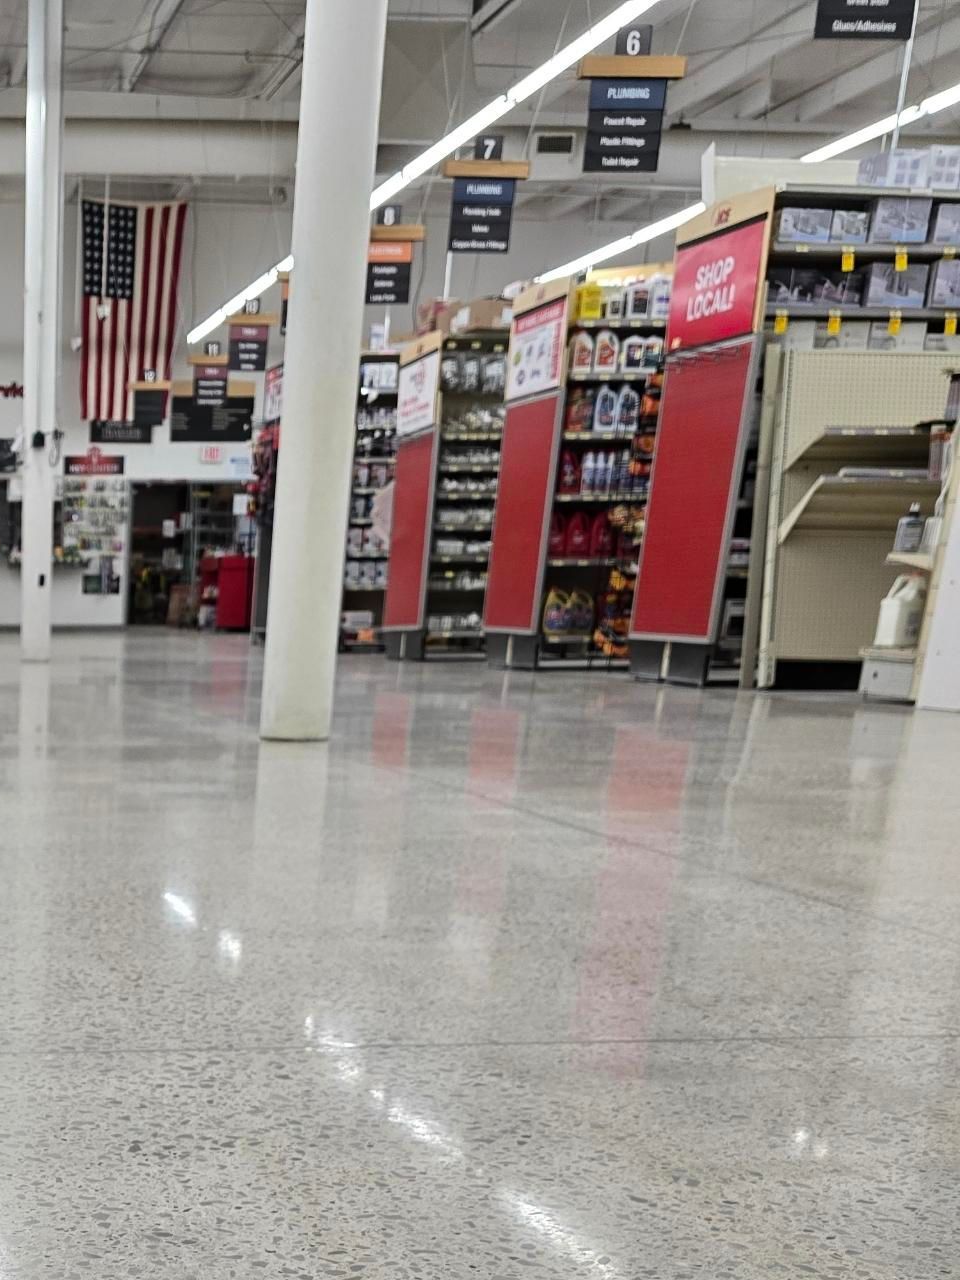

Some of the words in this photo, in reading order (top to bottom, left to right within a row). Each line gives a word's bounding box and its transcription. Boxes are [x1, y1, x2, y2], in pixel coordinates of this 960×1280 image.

[832, 19, 896, 32] Glues/Adhesives
[626, 30, 641, 56] 6
[607, 87, 650, 99] PLUMBING
[626, 117, 647, 127] Repair
[483, 138, 496, 160] 7
[619, 157, 640, 168] Repair
[466, 184, 503, 195] PLUMBING
[383, 206, 395, 226] 8
[695, 256, 735, 291] SHOP
[686, 283, 736, 323] LOCAL!
[203, 447, 219, 460] EXIT
